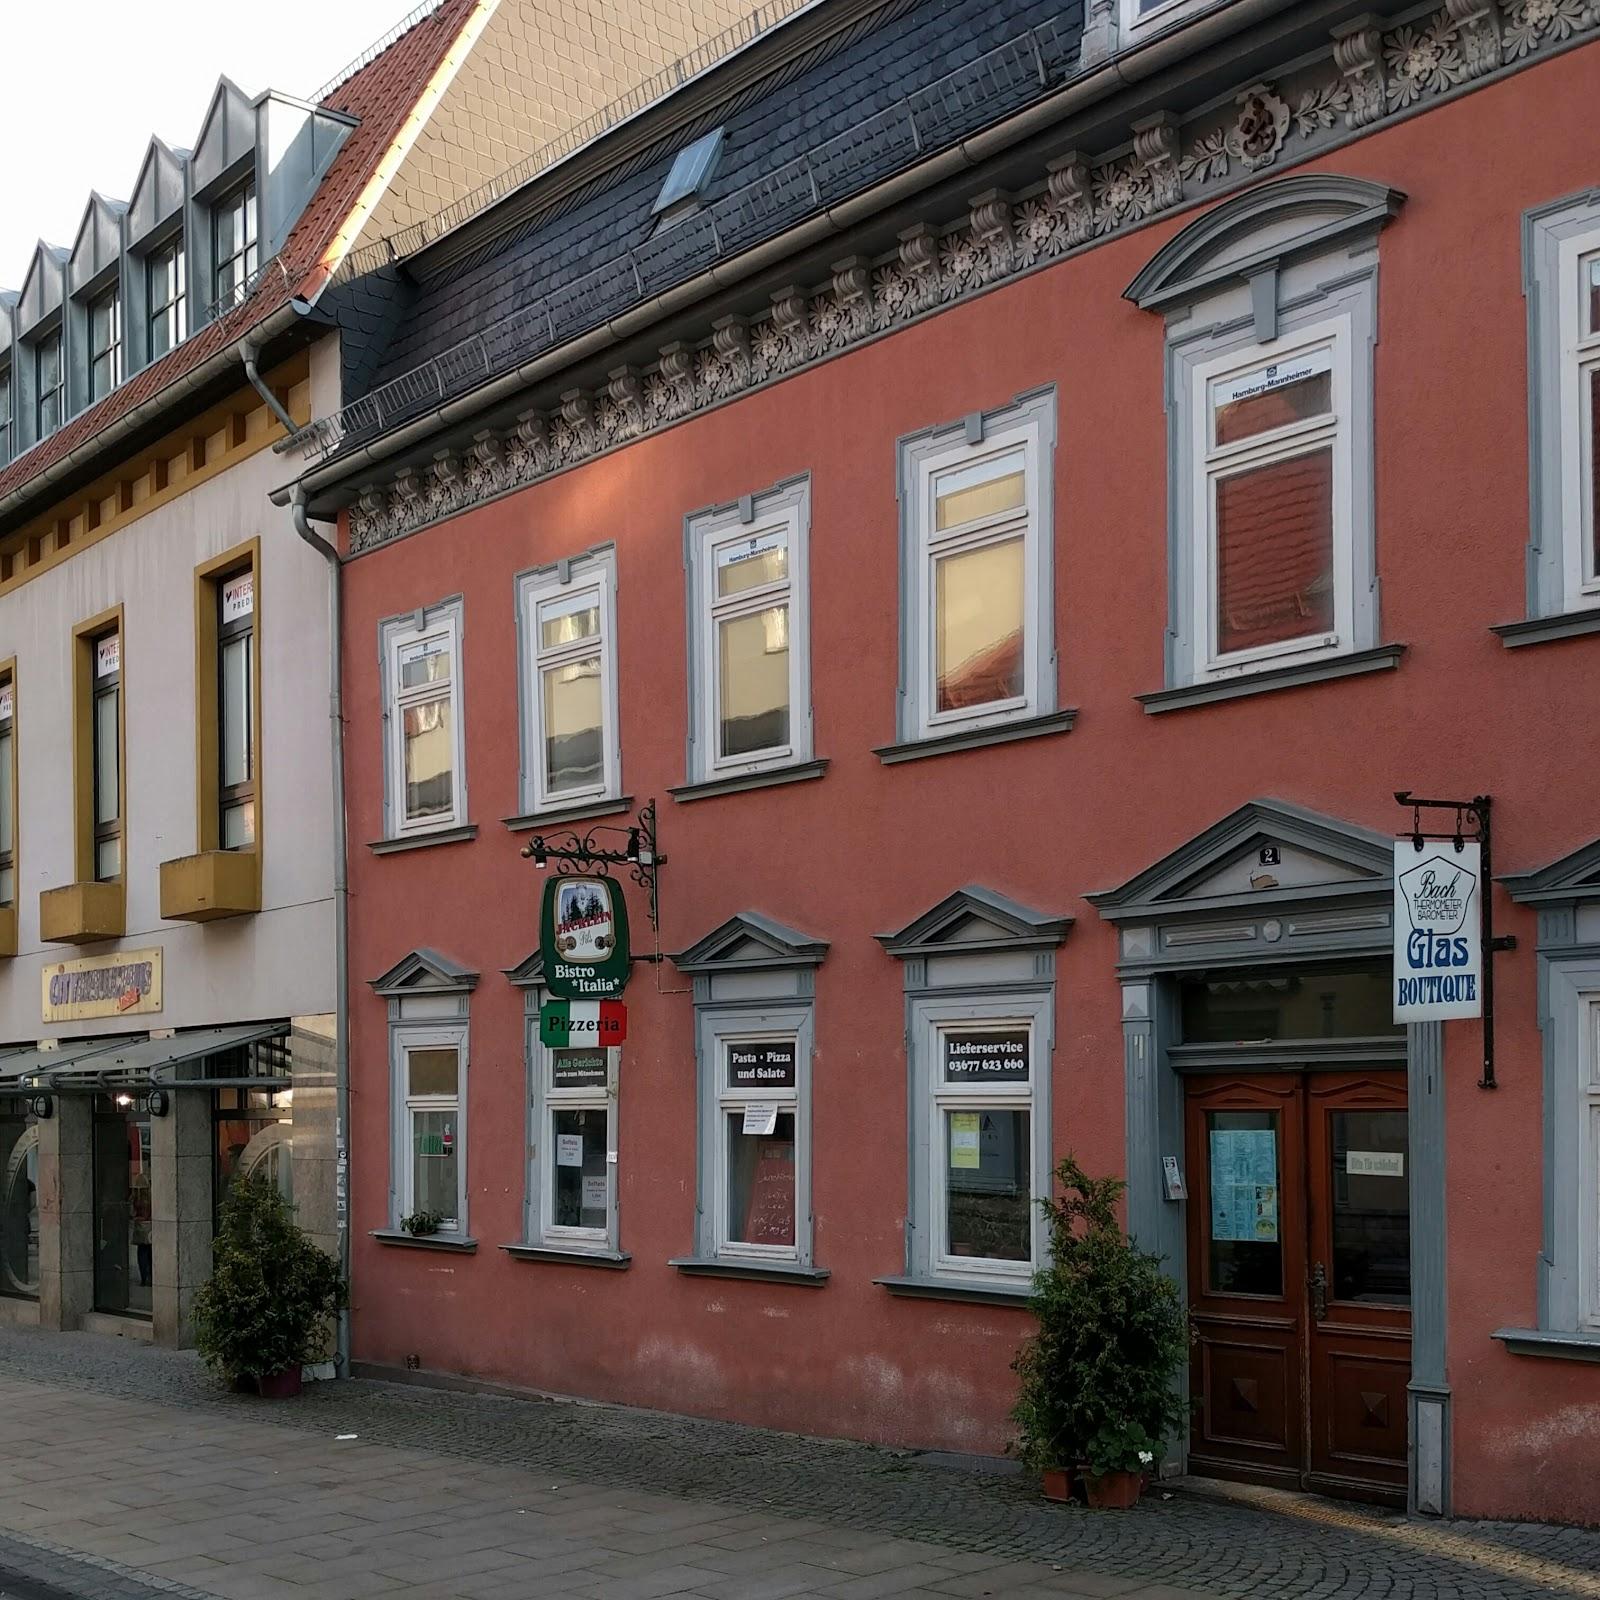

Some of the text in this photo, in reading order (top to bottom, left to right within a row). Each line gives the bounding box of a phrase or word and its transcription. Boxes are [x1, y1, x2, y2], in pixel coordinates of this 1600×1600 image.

[1232, 368, 1312, 400] Hamburg-Mannheimer
[1265, 849, 1273, 862] 2
[1414, 870, 1461, 899] Bach
[1413, 899, 1462, 910] THERMOMETER
[1417, 910, 1458, 921] BAROMETER
[1407, 928, 1469, 969] Glas
[555, 965, 595, 978] Bistro
[1398, 974, 1476, 1006] BOUTIQUE
[549, 1016, 620, 1032] Pizzeria
[949, 1041, 1024, 1055] Lieferservice
[732, 1052, 791, 1063] Pasta Pizza
[948, 1058, 1024, 1072] 03677 623 660
[737, 1067, 786, 1078] und Salate
